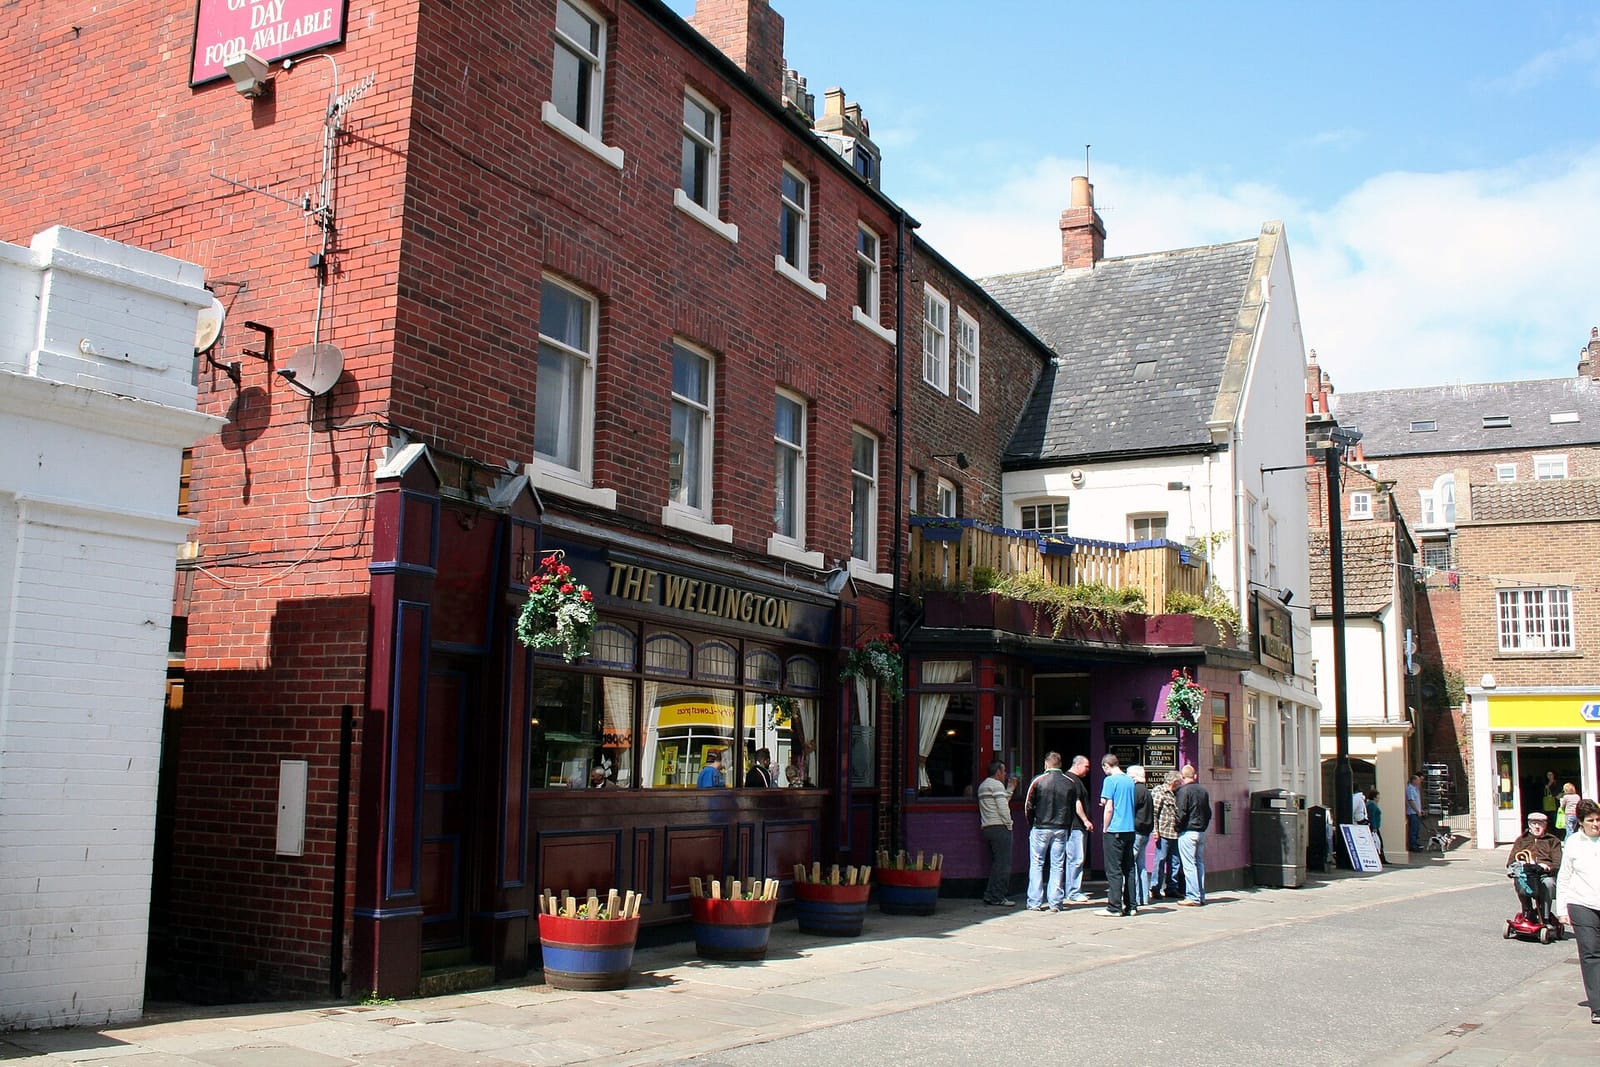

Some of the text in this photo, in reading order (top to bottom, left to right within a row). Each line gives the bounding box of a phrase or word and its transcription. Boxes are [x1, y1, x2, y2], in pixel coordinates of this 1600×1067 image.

[204, 8, 333, 66] FOOD AVAILABLE
[250, 0, 286, 29] DAY
[609, 561, 792, 629] THE WELLINGTON
